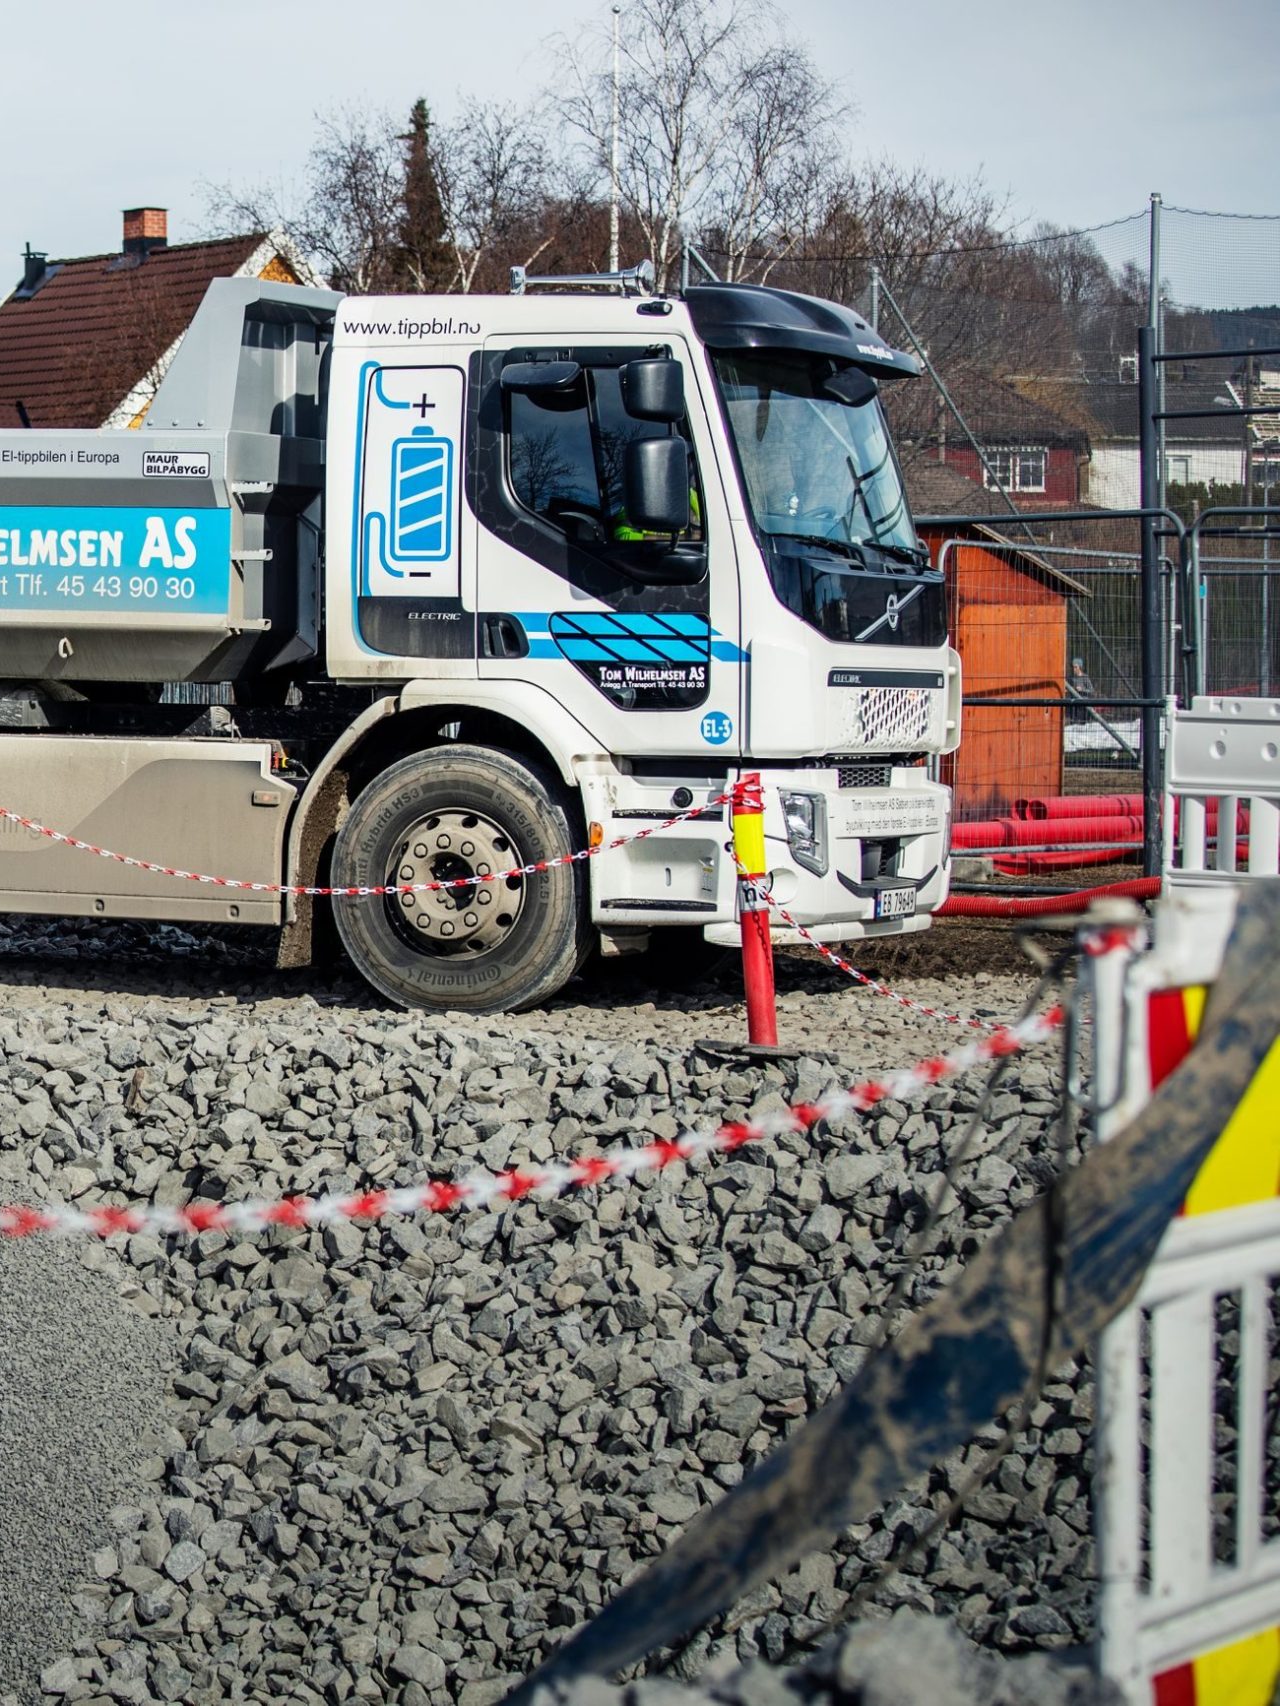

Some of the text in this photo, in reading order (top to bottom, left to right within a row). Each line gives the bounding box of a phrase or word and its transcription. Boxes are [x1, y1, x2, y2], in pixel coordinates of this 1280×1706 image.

[343, 317, 481, 339] www.tippbil.no
[2, 450, 67, 466] El-tippbilen
[70, 450, 74, 463] i
[77, 451, 120, 466] Europa
[146, 454, 179, 464] MAUR
[146, 463, 206, 475] BILPÅBYGG
[139, 515, 197, 570] AS
[16, 573, 48, 596] Tlf.
[56, 575, 85, 597] 45
[93, 576, 121, 598] 43
[129, 576, 158, 598] 90
[166, 577, 195, 599] 30
[408, 612, 462, 620] ELECTRIC
[599, 667, 705, 680] TOM WILHELMSEN AS
[600, 681, 621, 689] Anlegg
[628, 681, 657, 689] Transport
[702, 719, 731, 738] EL-3
[392, 787, 420, 810] HS3
